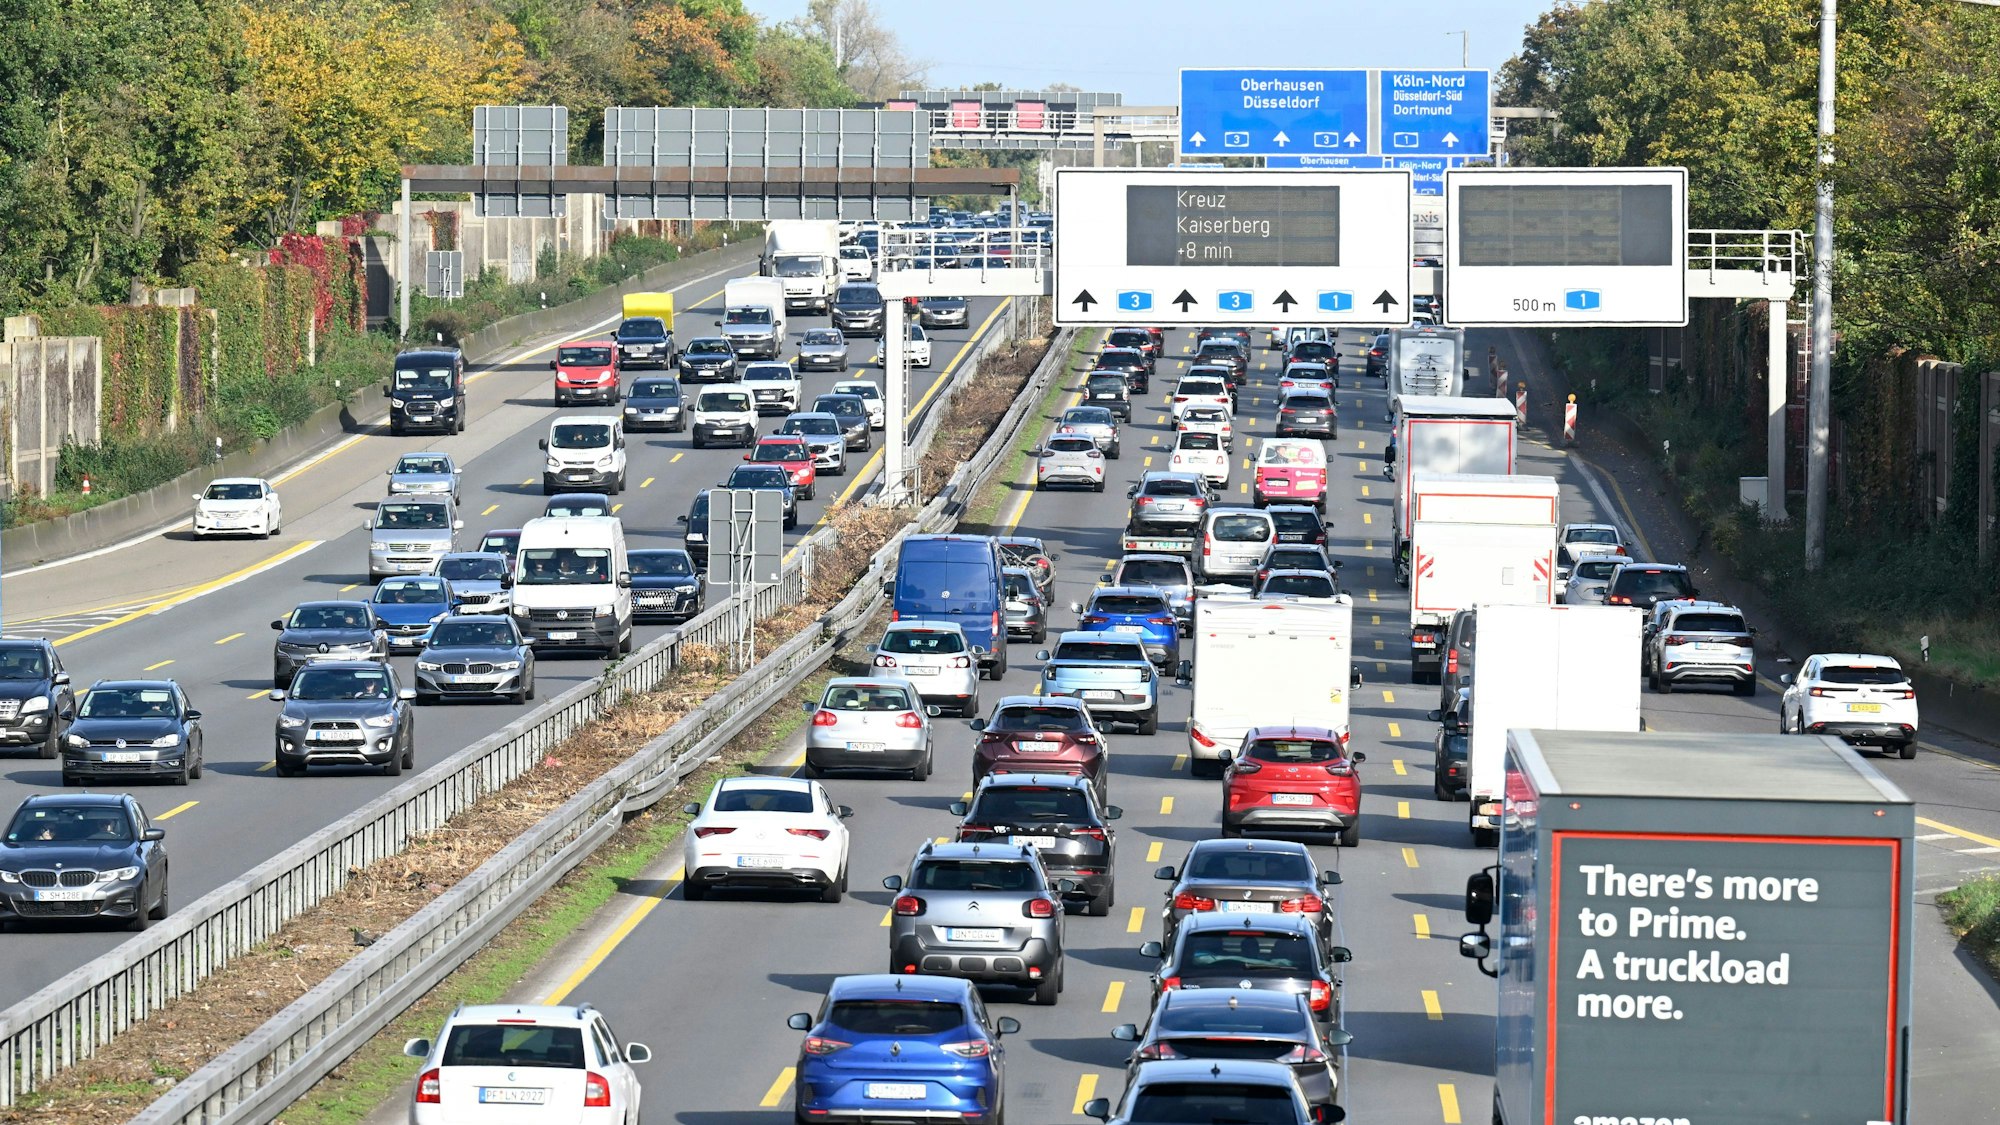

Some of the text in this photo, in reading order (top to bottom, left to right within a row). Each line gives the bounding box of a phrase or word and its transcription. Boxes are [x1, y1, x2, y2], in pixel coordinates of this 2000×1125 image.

[1240, 78, 1324, 91] Oberhausen
[1393, 74, 1465, 88] Köln-Nord
[1243, 95, 1320, 109] Düsseldorf
[1393, 89, 1463, 102] Düsseldorf-Süd
[1393, 104, 1453, 115] Dortmund
[1233, 134, 1330, 145] 3 3
[1300, 157, 1349, 165] Oberhausen
[1399, 161, 1442, 169] Köln-Nord
[1177, 190, 1226, 208] Kreuz
[1177, 216, 1270, 237] Kaiserberg
[1178, 241, 1232, 259] +8 min
[1130, 294, 1338, 308] 3 3 1
[1513, 293, 1586, 311] 500 m 1
[1723, 876, 1819, 902] more
[1578, 906, 1747, 941] to Prime.
[1576, 949, 1790, 985] A truckload
[1577, 994, 1683, 1020] more.
